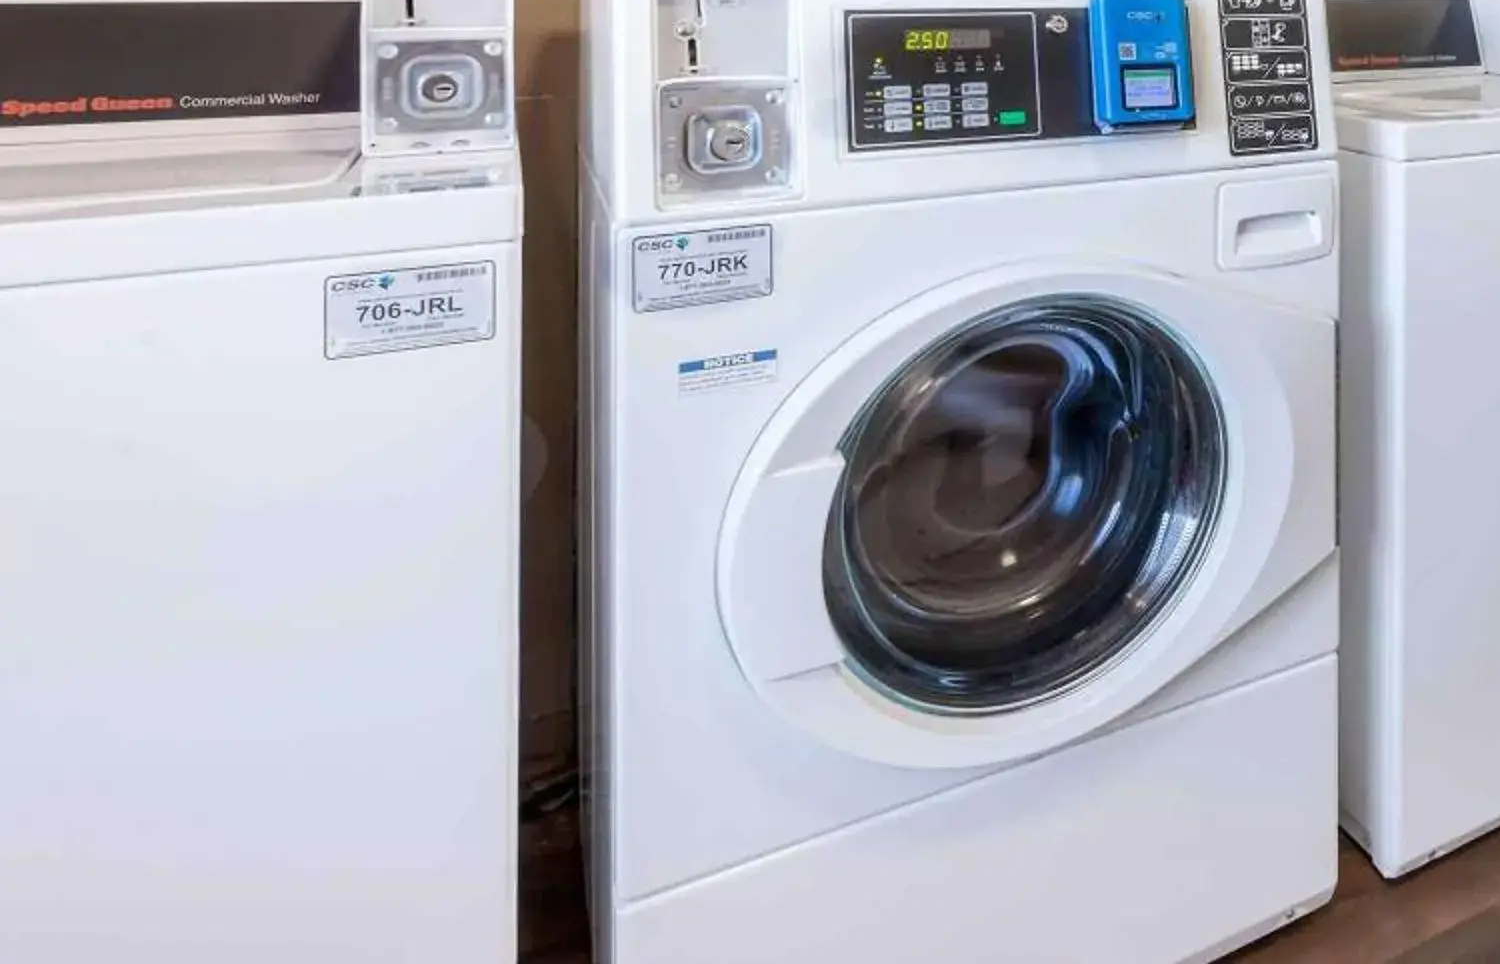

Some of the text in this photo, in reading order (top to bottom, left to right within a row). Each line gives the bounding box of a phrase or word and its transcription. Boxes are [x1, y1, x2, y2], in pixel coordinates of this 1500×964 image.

[1, 91, 320, 117] Speed Queen Commercial Washer
[637, 239, 674, 252] CSC
[657, 253, 748, 281] 770-JRK
[331, 277, 376, 293] CSC
[355, 295, 464, 324] 706-JRL
